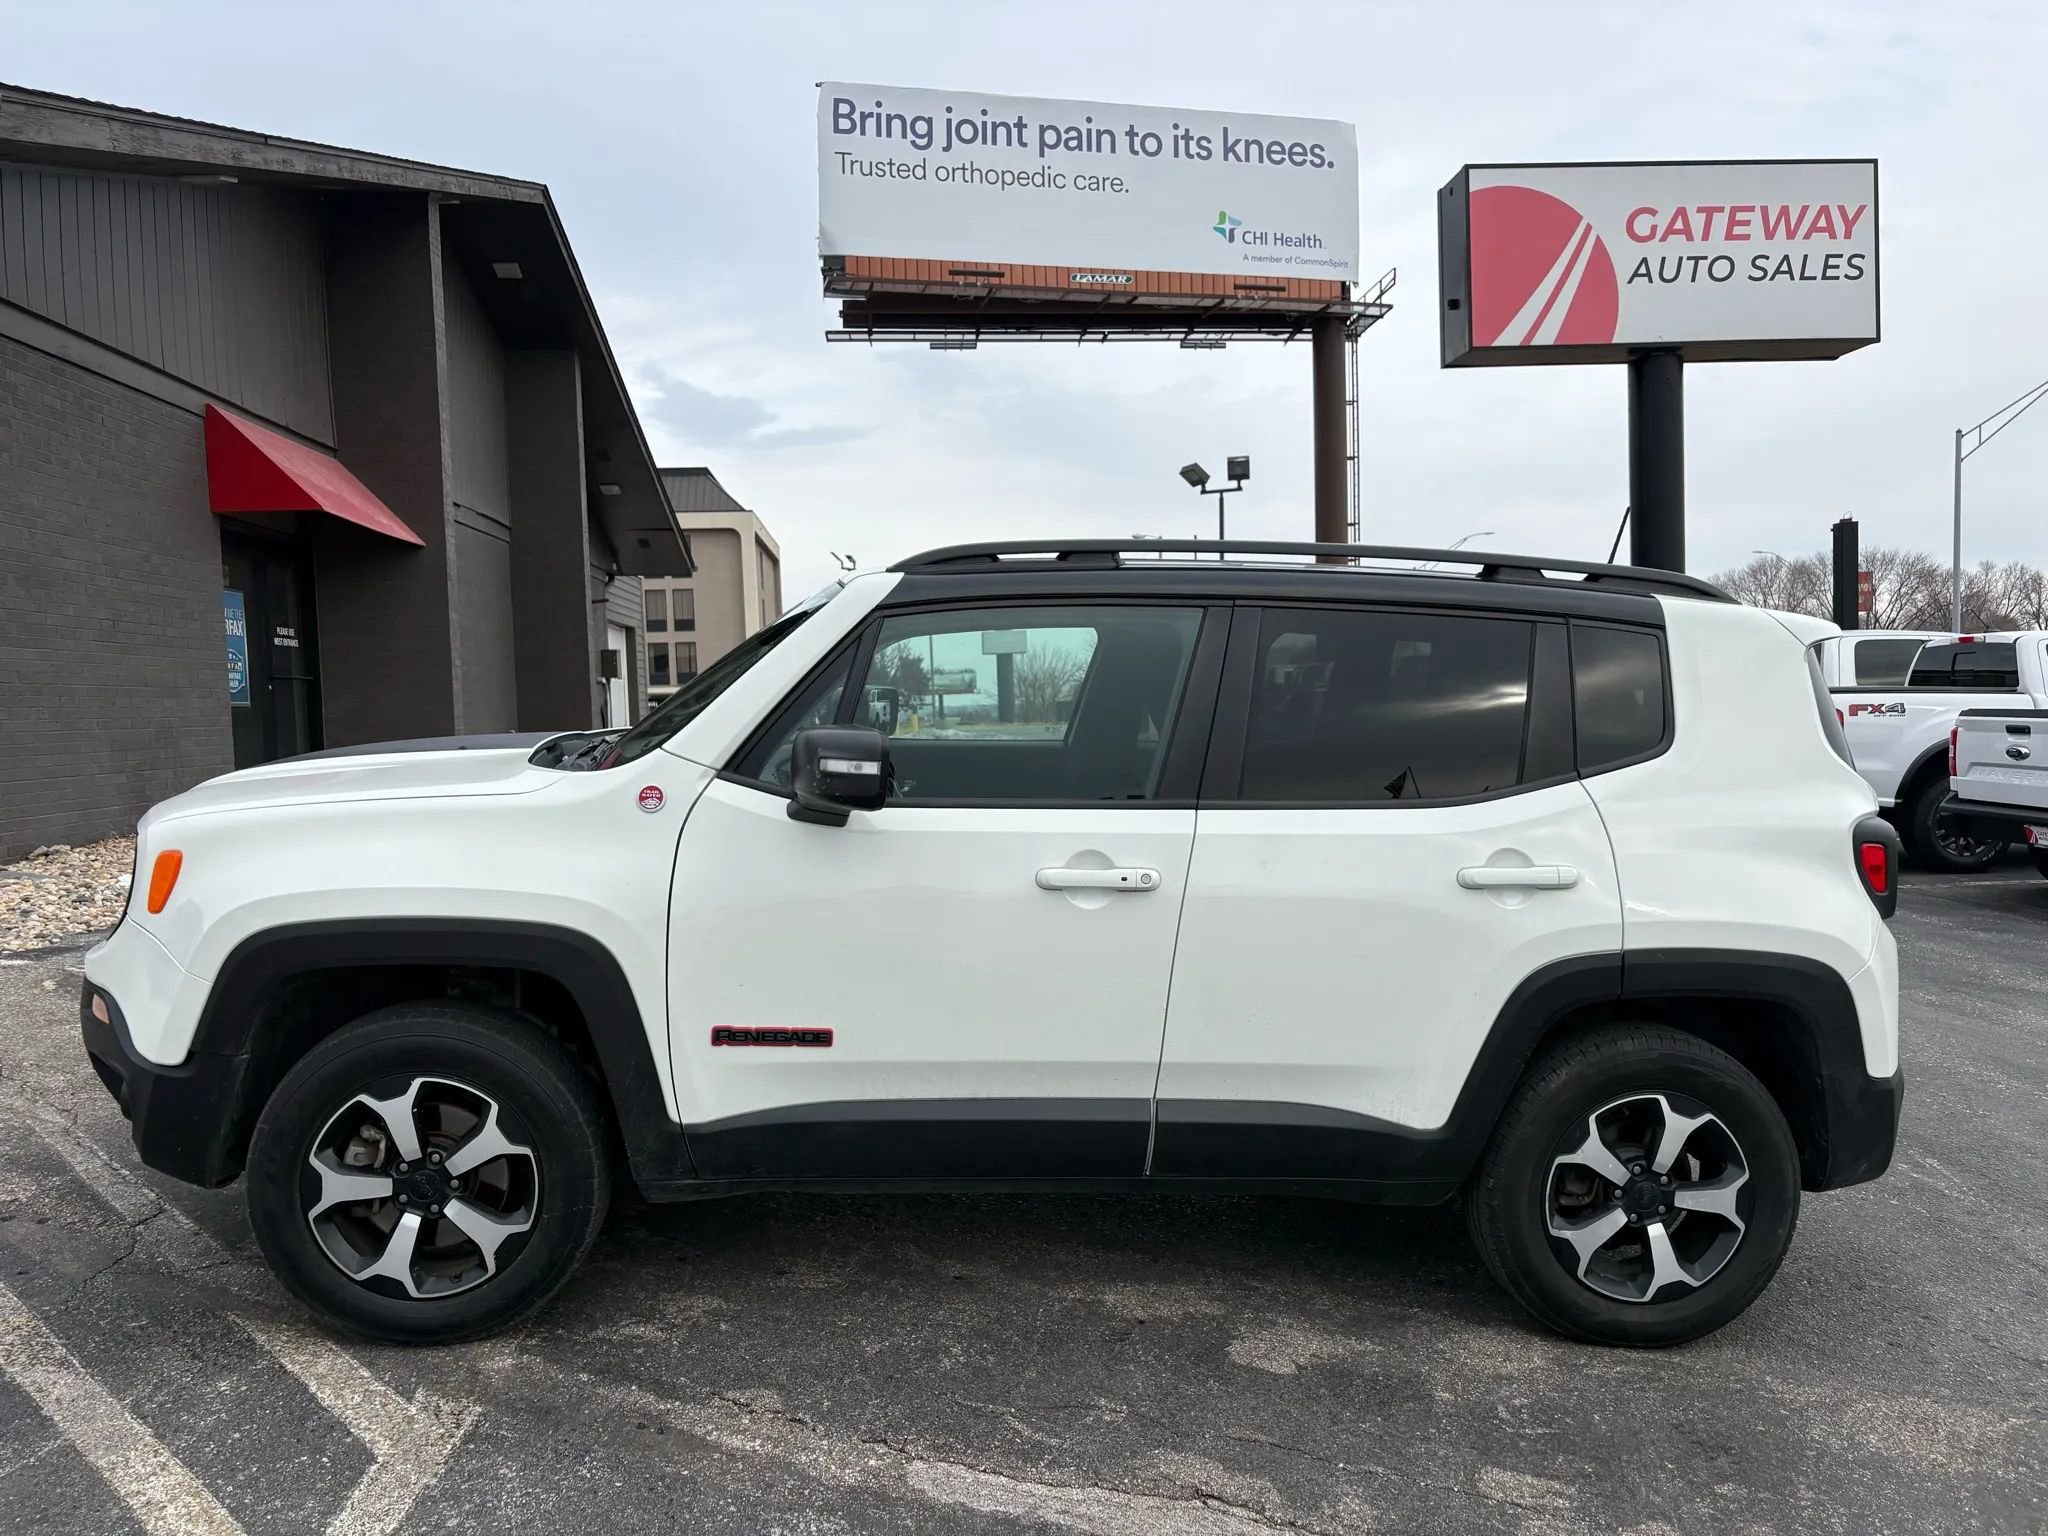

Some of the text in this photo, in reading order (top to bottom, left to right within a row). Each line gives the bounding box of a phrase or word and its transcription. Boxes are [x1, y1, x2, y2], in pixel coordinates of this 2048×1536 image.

[832, 97, 1335, 169] Bring joint pain to its knees.
[834, 151, 1130, 194] Trusted orthopedic care.
[1625, 204, 1868, 243] GATEWAY
[1242, 230, 1323, 249] CHI Health
[1242, 253, 1349, 269] A member of CommonSpirit
[1627, 253, 1866, 284] AUTO SALES
[1075, 273, 1128, 284] LAMAR
[225, 618, 244, 637] RFAX
[1848, 702, 1906, 717] FX4
[715, 1029, 830, 1043] RENEGADE
